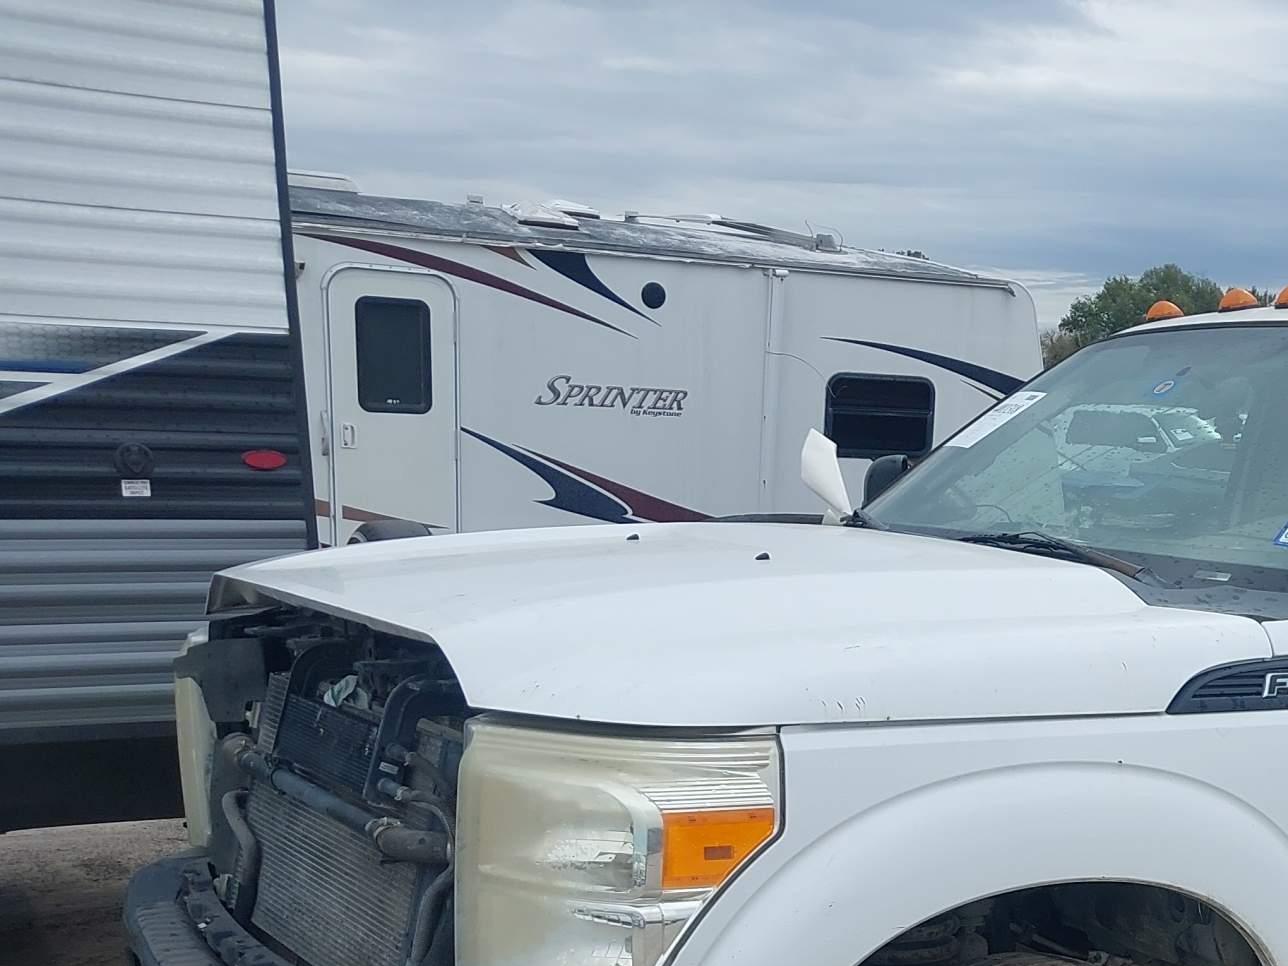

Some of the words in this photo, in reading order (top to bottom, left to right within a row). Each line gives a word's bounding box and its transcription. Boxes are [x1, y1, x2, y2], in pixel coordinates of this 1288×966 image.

[534, 374, 688, 411] SPRINTER
[630, 408, 641, 416] by
[642, 409, 682, 417] Keystone
